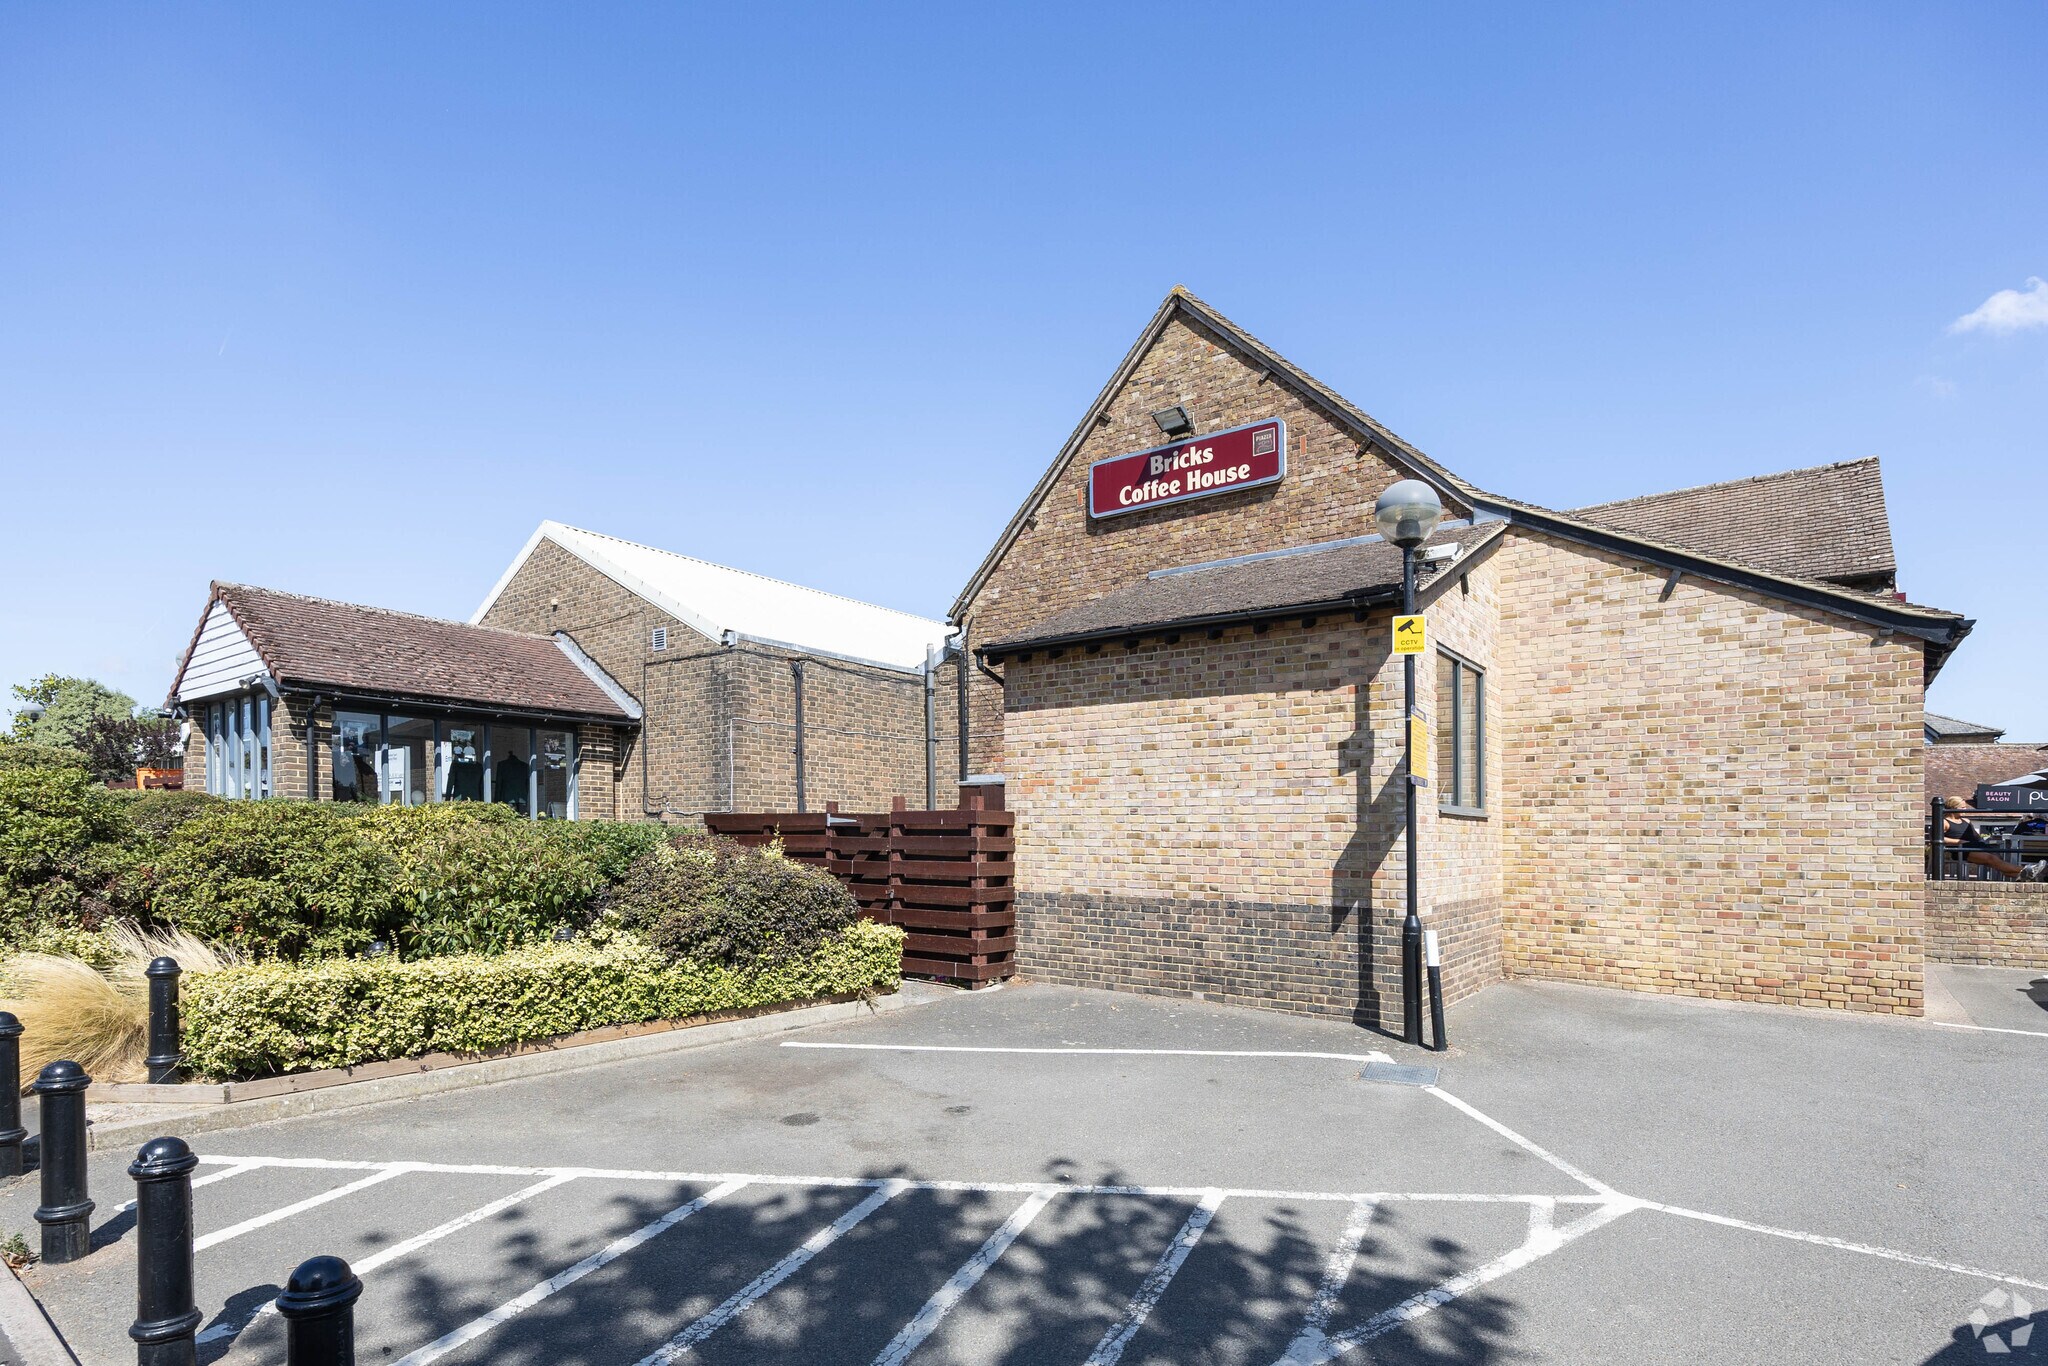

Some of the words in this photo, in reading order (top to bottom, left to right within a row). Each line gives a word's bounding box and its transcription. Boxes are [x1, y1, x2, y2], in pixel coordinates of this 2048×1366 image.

[1150, 446, 1214, 476] Bricks
[1119, 479, 1181, 505] Coffee
[1187, 463, 1251, 491] House
